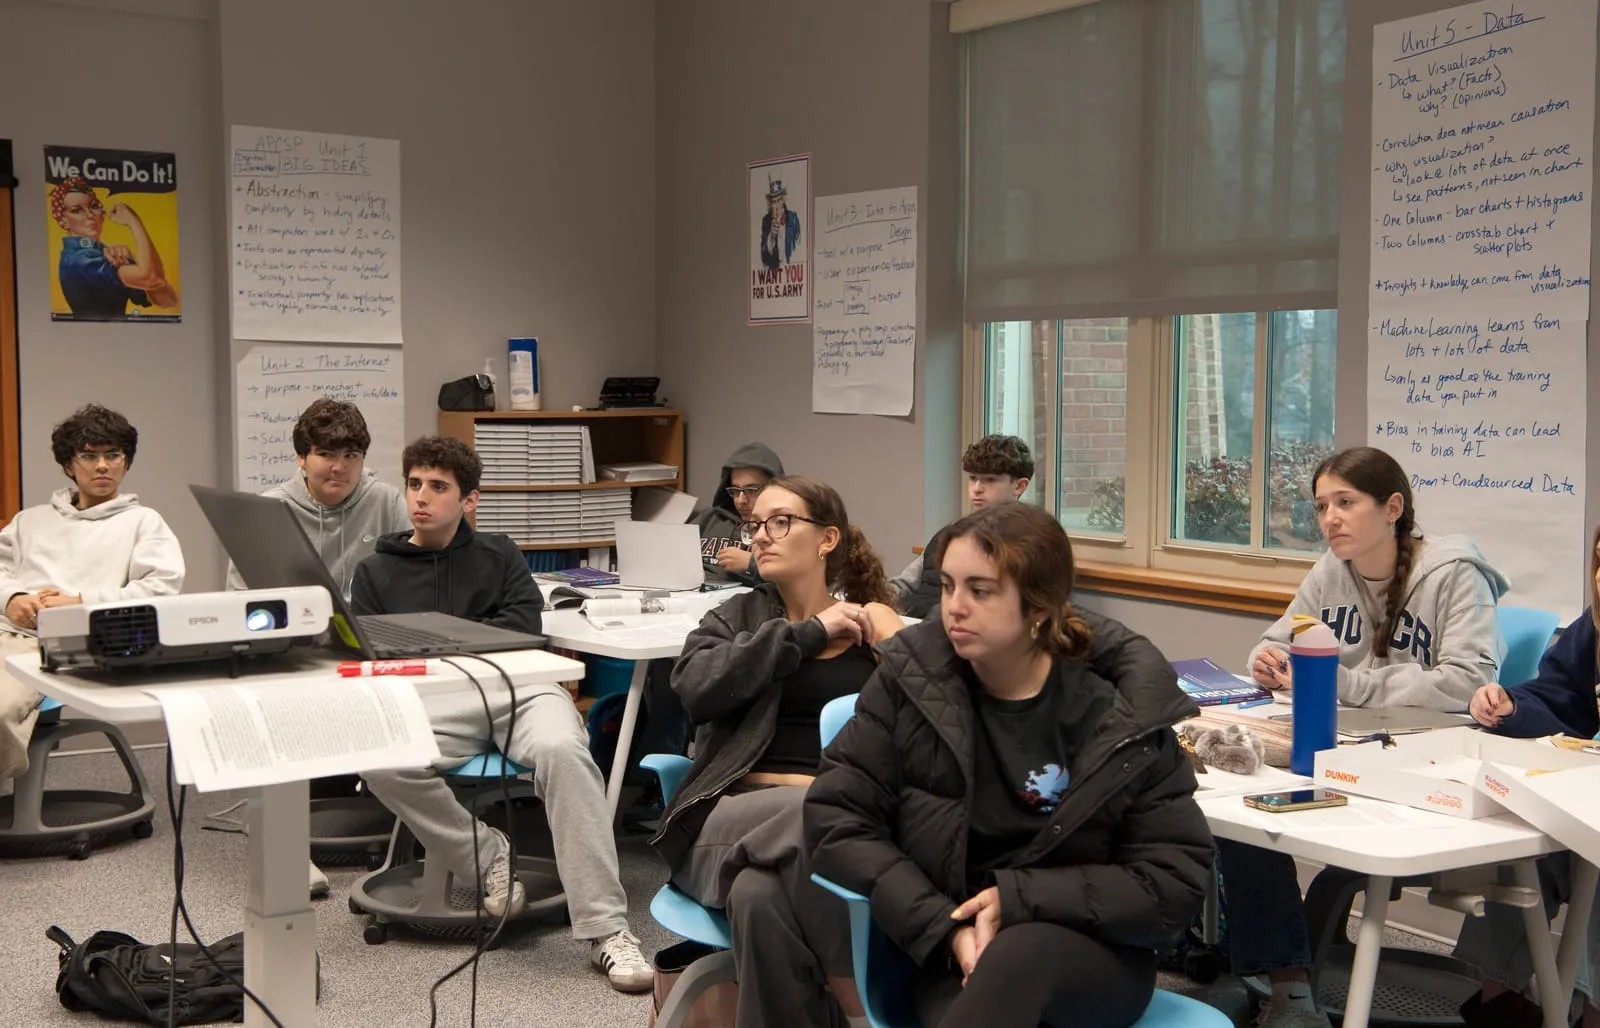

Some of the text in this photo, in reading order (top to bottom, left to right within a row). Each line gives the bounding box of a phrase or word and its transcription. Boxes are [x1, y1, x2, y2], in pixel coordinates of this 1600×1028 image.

[1401, 4, 1527, 53] Unit 5 Data
[1388, 45, 1514, 89] Data Visualization
[1452, 80, 1507, 109] (Opinions)
[1382, 99, 1569, 152] Correlation does not mean causation
[319, 141, 350, 156] Unit
[48, 156, 174, 184] We Can Do It!
[283, 157, 367, 173] BIG IDEAS
[1406, 169, 1433, 186] look
[1448, 163, 1468, 178] lots
[1472, 158, 1488, 171] of
[1490, 150, 1515, 168] data
[1520, 149, 1538, 161] at
[1544, 143, 1570, 156] once
[246, 180, 319, 199] Abstraction
[1406, 193, 1423, 203] see
[1481, 175, 1500, 187] not
[1503, 171, 1526, 182] seen
[1529, 166, 1542, 177] in
[1544, 160, 1584, 175] chart
[303, 204, 315, 223] by
[826, 207, 848, 226] Unit
[1383, 213, 1401, 227] One
[1405, 208, 1443, 224] Column
[1455, 204, 1477, 218] bar
[1479, 198, 1513, 215] charts
[1526, 192, 1584, 213] histograms
[1381, 235, 1402, 250] Two
[1406, 232, 1447, 246] Columns
[1455, 225, 1502, 241] crosstab
[1506, 222, 1539, 237] chart
[752, 264, 804, 286] I WANT YOU
[1383, 278, 1417, 297] Insights
[1429, 273, 1469, 294] knowledge
[1470, 276, 1488, 286] can
[1491, 275, 1511, 284] come
[1514, 270, 1533, 281] from
[752, 288, 764, 300] FOR
[1380, 313, 1561, 345] Machine Learning learns from
[1406, 341, 1425, 358] lots
[1445, 342, 1465, 357] lots
[1476, 344, 1494, 354] of
[1500, 337, 1531, 354] data
[262, 354, 390, 371] Unit 2 The Internet
[265, 383, 301, 399] purpose
[1395, 371, 1416, 391] only
[1438, 368, 1464, 391] good
[1483, 368, 1503, 382] the
[1507, 368, 1551, 392] training
[1406, 389, 1498, 408] data you put in
[1386, 420, 1561, 442] Bias in training data can lead
[1411, 440, 1486, 458] to bias AI
[1410, 473, 1438, 492] Open
[1452, 472, 1534, 492] Crowdsourced
[1542, 473, 1575, 495] Data
[188, 616, 218, 626] EPSON
